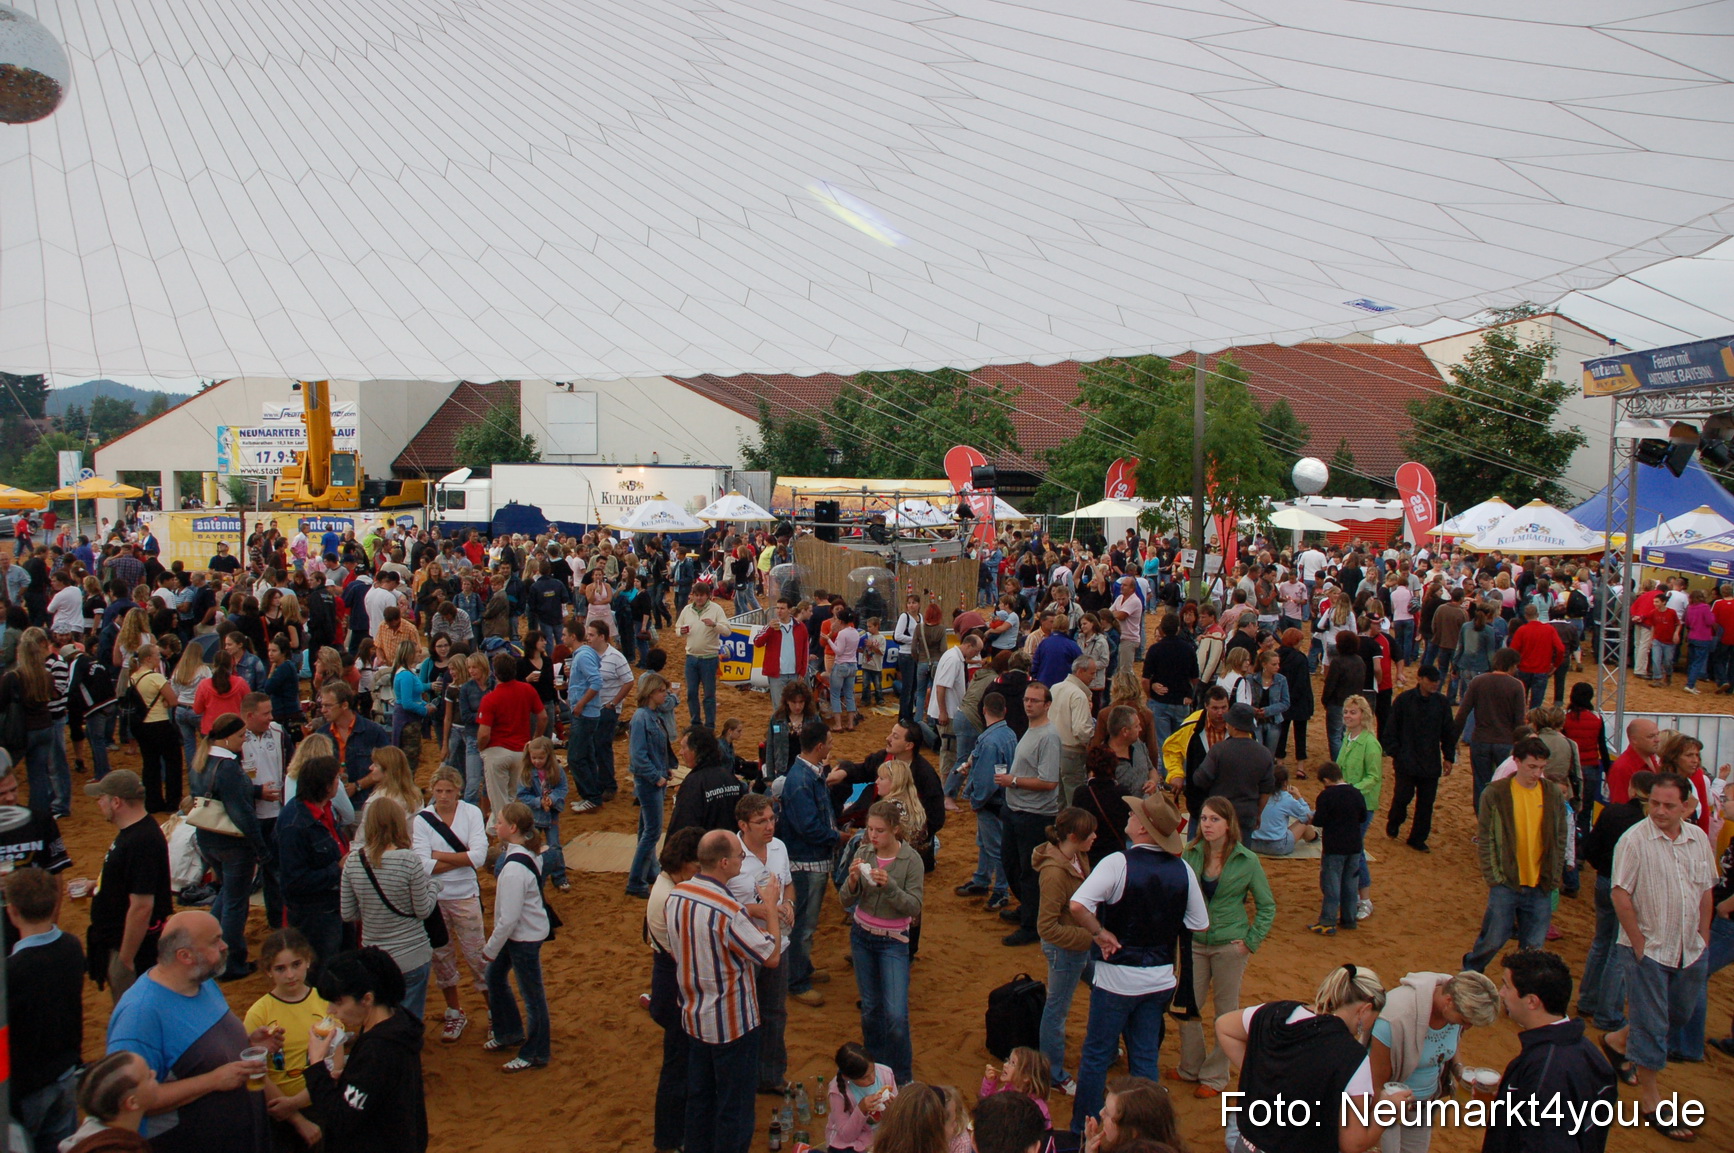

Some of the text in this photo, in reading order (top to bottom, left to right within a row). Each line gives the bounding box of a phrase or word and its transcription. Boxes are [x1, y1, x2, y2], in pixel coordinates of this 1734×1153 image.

[1651, 350, 1692, 370] Feiern mit
[1647, 365, 1714, 385] ANTENNE BAYERN!
[240, 428, 301, 437] NEUMARKTER
[197, 519, 241, 530] antenne
[1496, 531, 1566, 546] KULMBACHER
[705, 786, 725, 798] bruno
[344, 1083, 369, 1110] XXL
